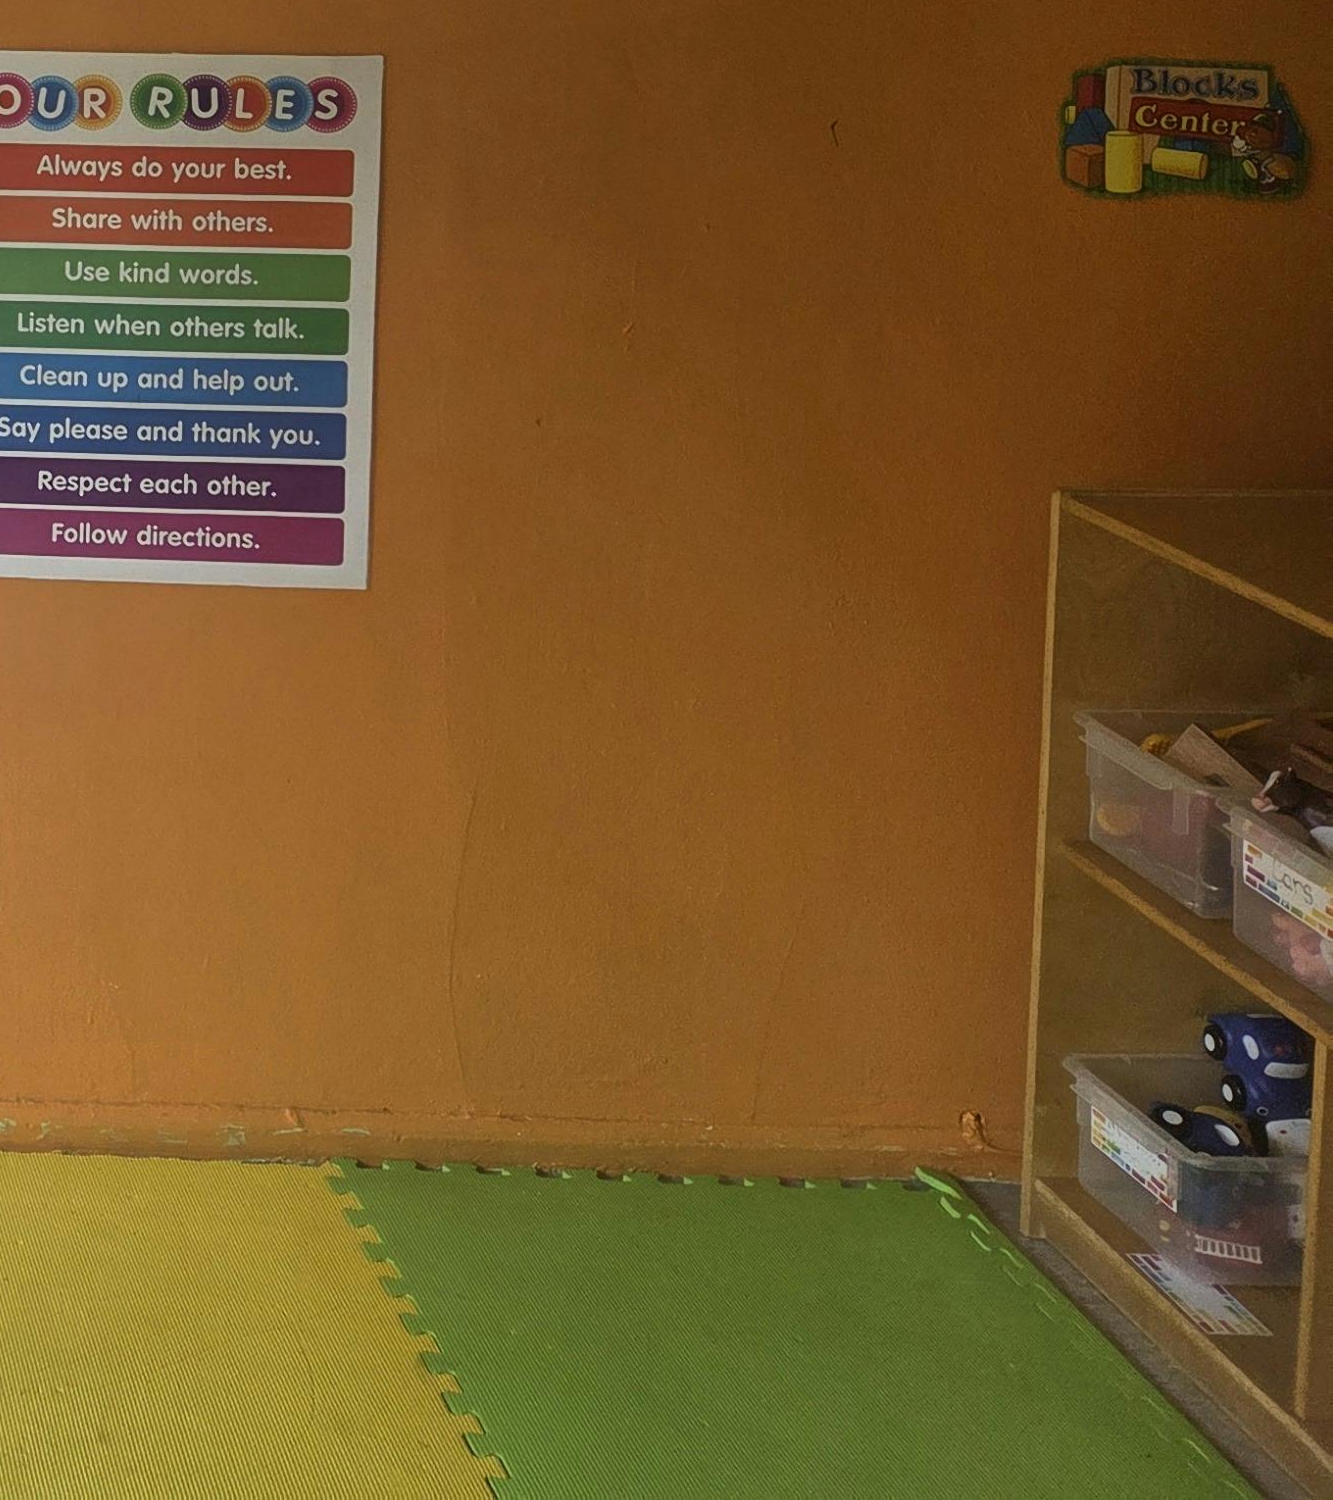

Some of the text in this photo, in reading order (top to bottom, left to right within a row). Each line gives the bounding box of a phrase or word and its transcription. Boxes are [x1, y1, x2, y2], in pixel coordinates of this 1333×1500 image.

[1133, 68, 1259, 98] Blocks
[148, 86, 339, 121] RULES
[1135, 104, 1245, 137] Center
[37, 156, 292, 184] Always do your best.
[52, 209, 274, 233] Share with others.
[65, 261, 259, 286] Use kind words.
[17, 313, 305, 340] Listen when others talk.
[19, 366, 300, 395] Clean up and help out.
[50, 419, 129, 443] please
[136, 422, 184, 443] and
[192, 423, 262, 445] thank
[270, 429, 321, 450] you.
[38, 471, 277, 498] Respect each other.
[51, 523, 261, 550] Follow directions.
